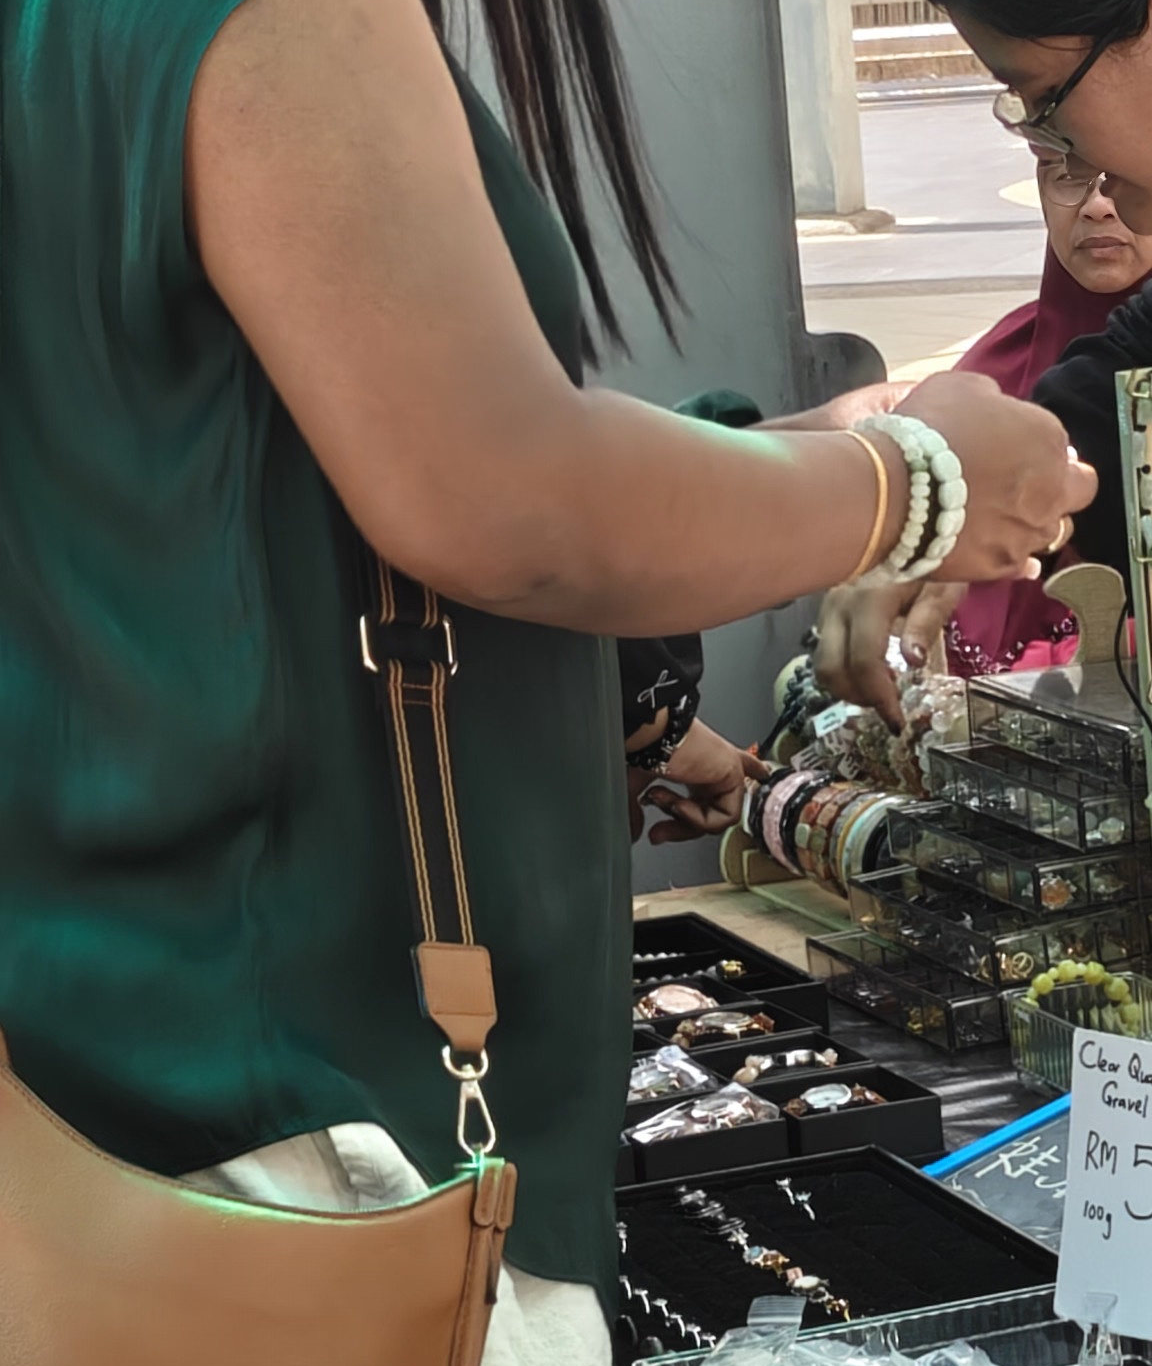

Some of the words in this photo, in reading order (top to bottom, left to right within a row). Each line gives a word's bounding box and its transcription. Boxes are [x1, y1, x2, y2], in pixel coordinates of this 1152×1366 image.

[1079, 1040, 1121, 1074] Clear
[1101, 1080, 1150, 1119] Gravel
[1083, 1129, 1119, 1176] RM
[1082, 1199, 1114, 1242] 100g
